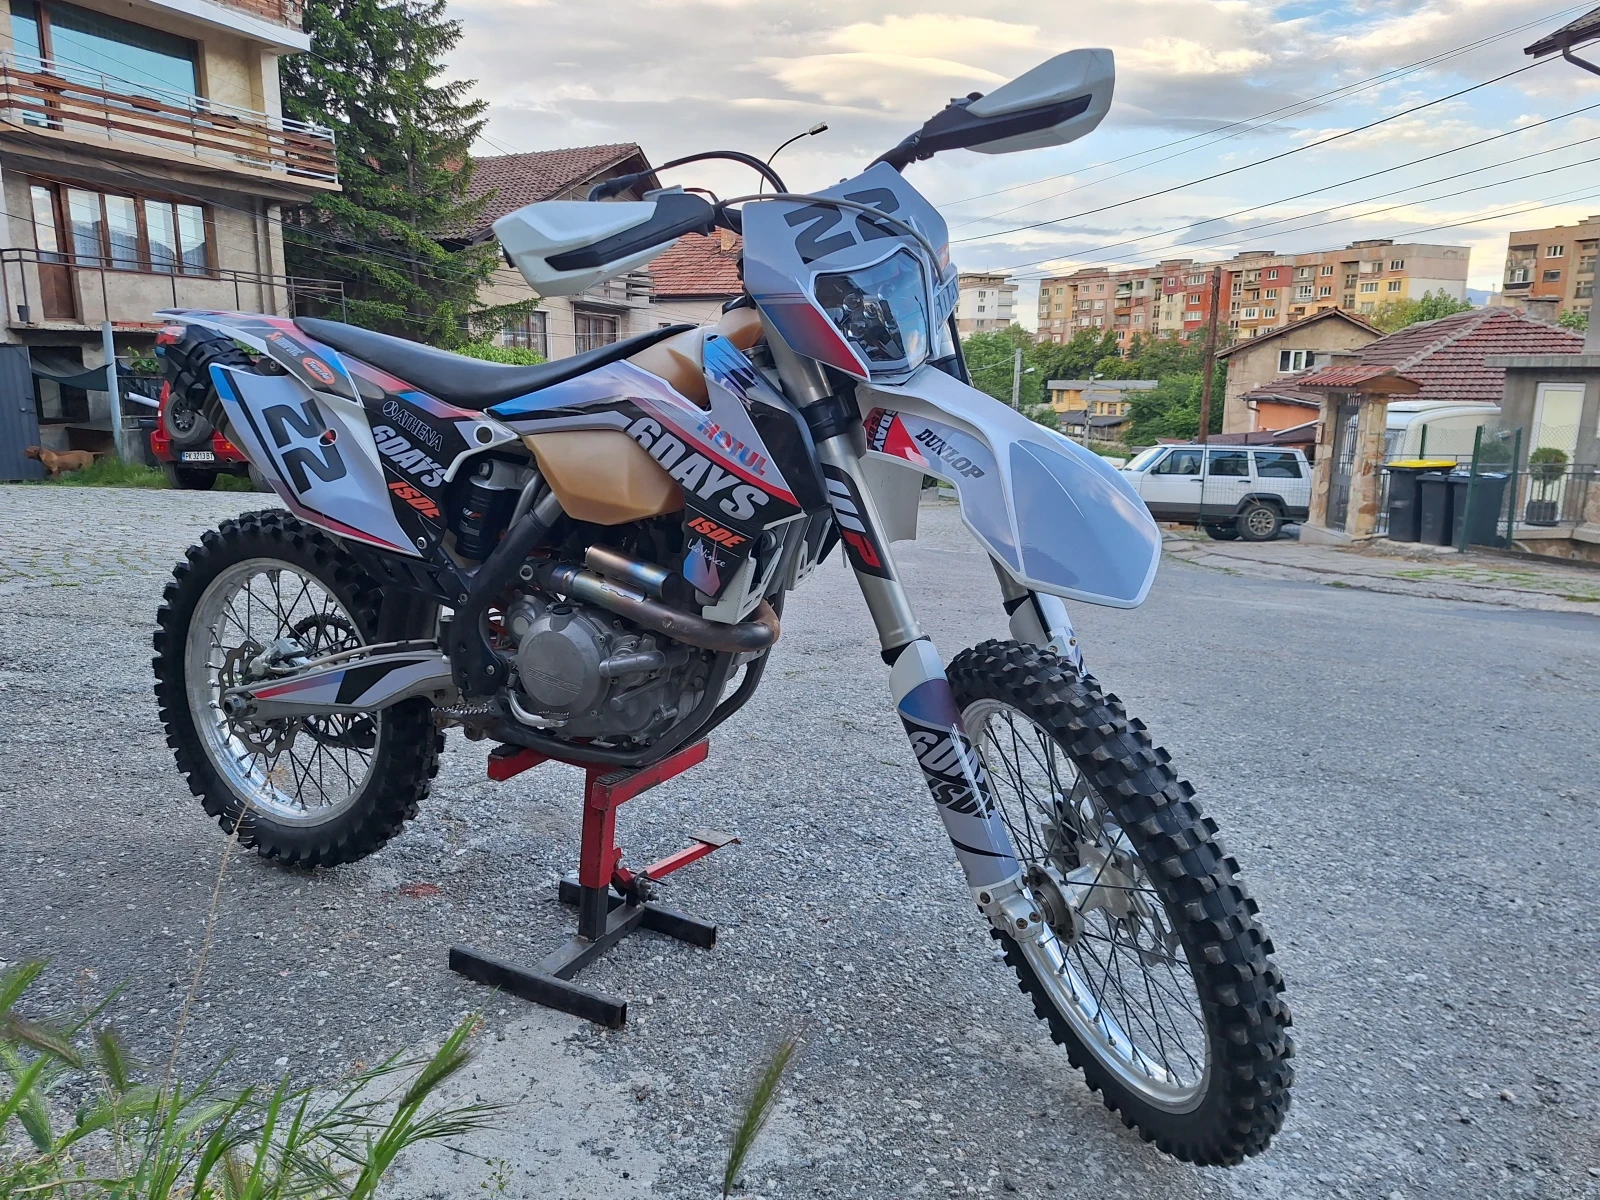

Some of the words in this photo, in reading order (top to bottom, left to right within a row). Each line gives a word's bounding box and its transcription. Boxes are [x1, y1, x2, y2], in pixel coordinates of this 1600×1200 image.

[783, 187, 914, 265] 22
[262, 398, 348, 495] 22
[372, 425, 448, 488] 6DAYS
[392, 408, 443, 452] ATHENA
[696, 420, 767, 476] MOTUL
[915, 428, 986, 479] DUNLOP
[628, 417, 770, 521] 6DAYS
[687, 516, 747, 548] ISDE
